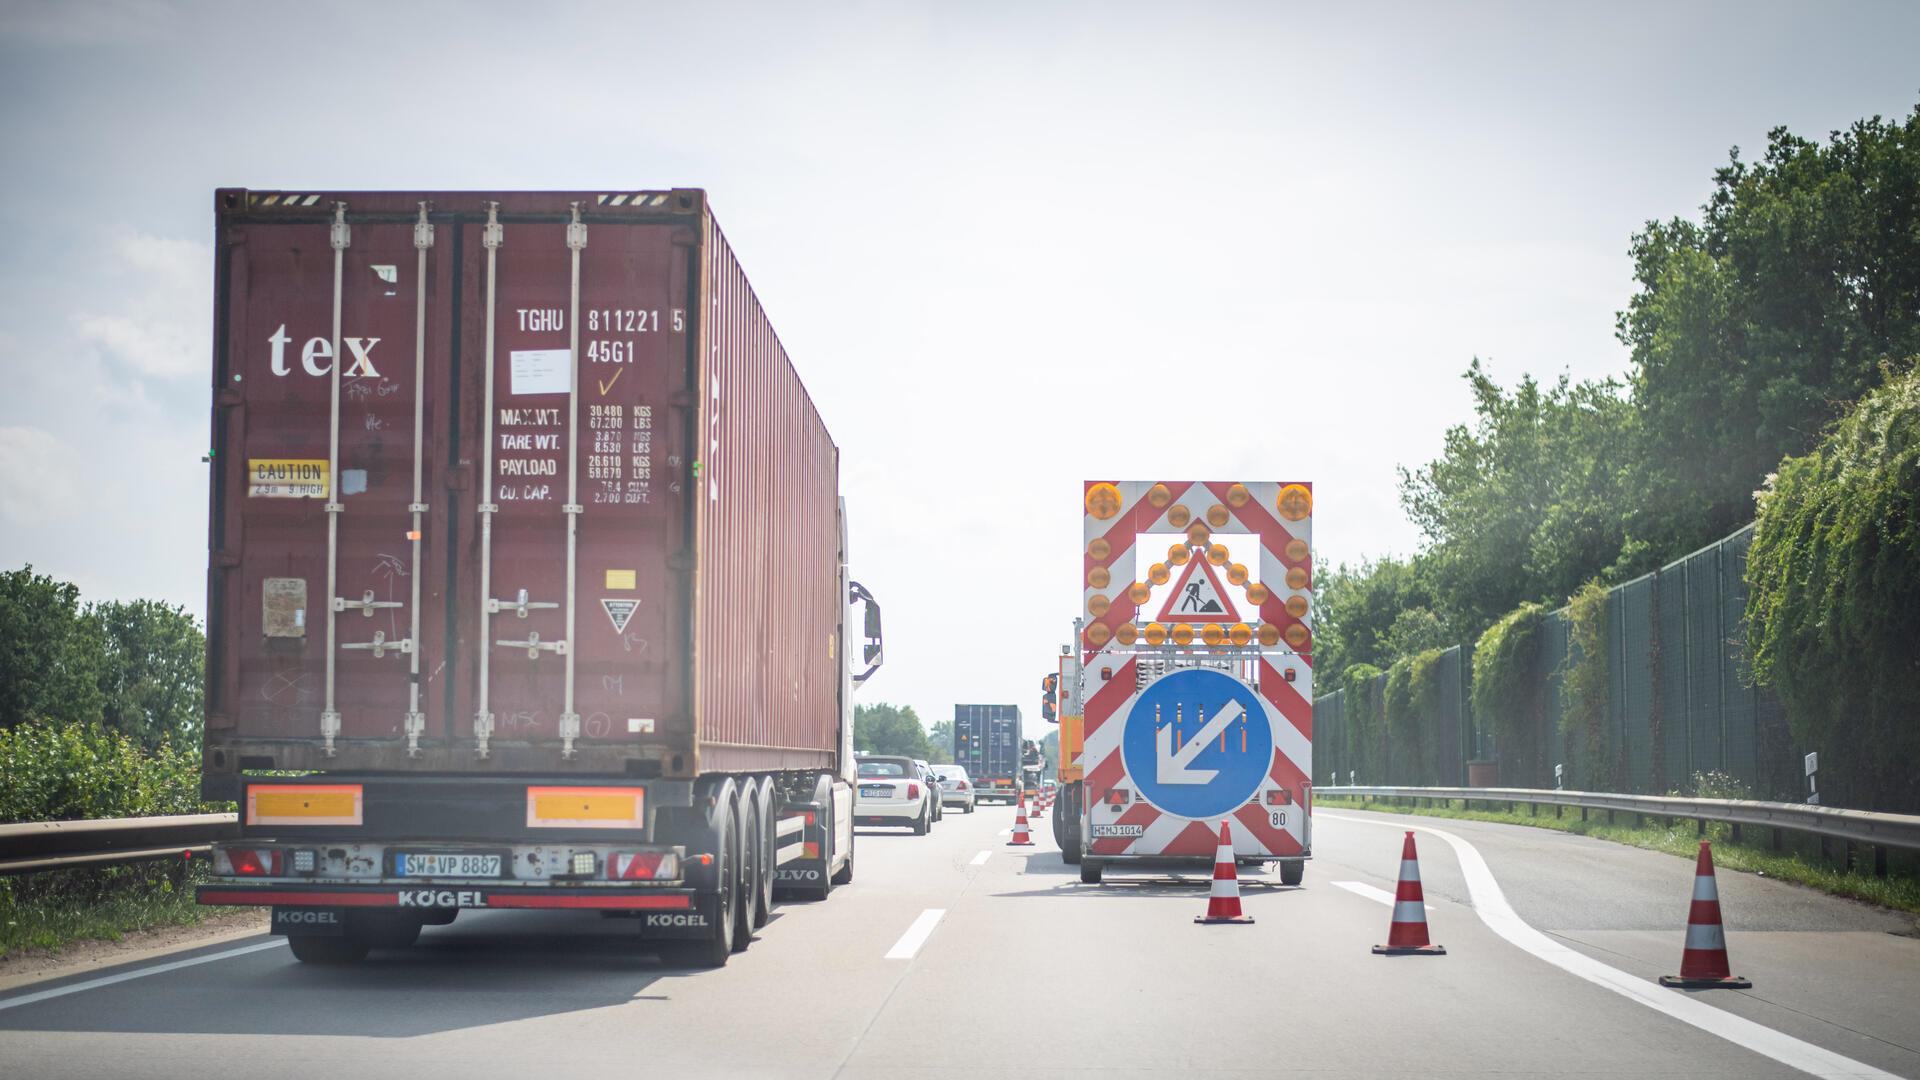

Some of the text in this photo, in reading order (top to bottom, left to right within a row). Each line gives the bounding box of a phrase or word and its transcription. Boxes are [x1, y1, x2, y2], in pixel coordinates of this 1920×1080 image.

[517, 309, 683, 332] TGHU 811221 5
[268, 323, 381, 377] tex
[587, 341, 633, 363] 45G1
[590, 405, 652, 417] 30.480 KGS
[590, 418, 652, 429] 67.200 LBS
[501, 434, 561, 450] TARE WT.
[595, 443, 651, 454] 8.530 LBS
[500, 459, 557, 476] PAYLOAD
[589, 455, 651, 467] 26.610 KGS
[258, 464, 321, 480] CAUTION
[589, 468, 651, 479] 58.670 LBS
[300, 484, 323, 494] HIGH
[523, 485, 552, 500] CAP.
[1272, 812, 1286, 826] 80
[406, 856, 499, 874] SW VP 8887
[398, 889, 488, 907] KÖGEL
